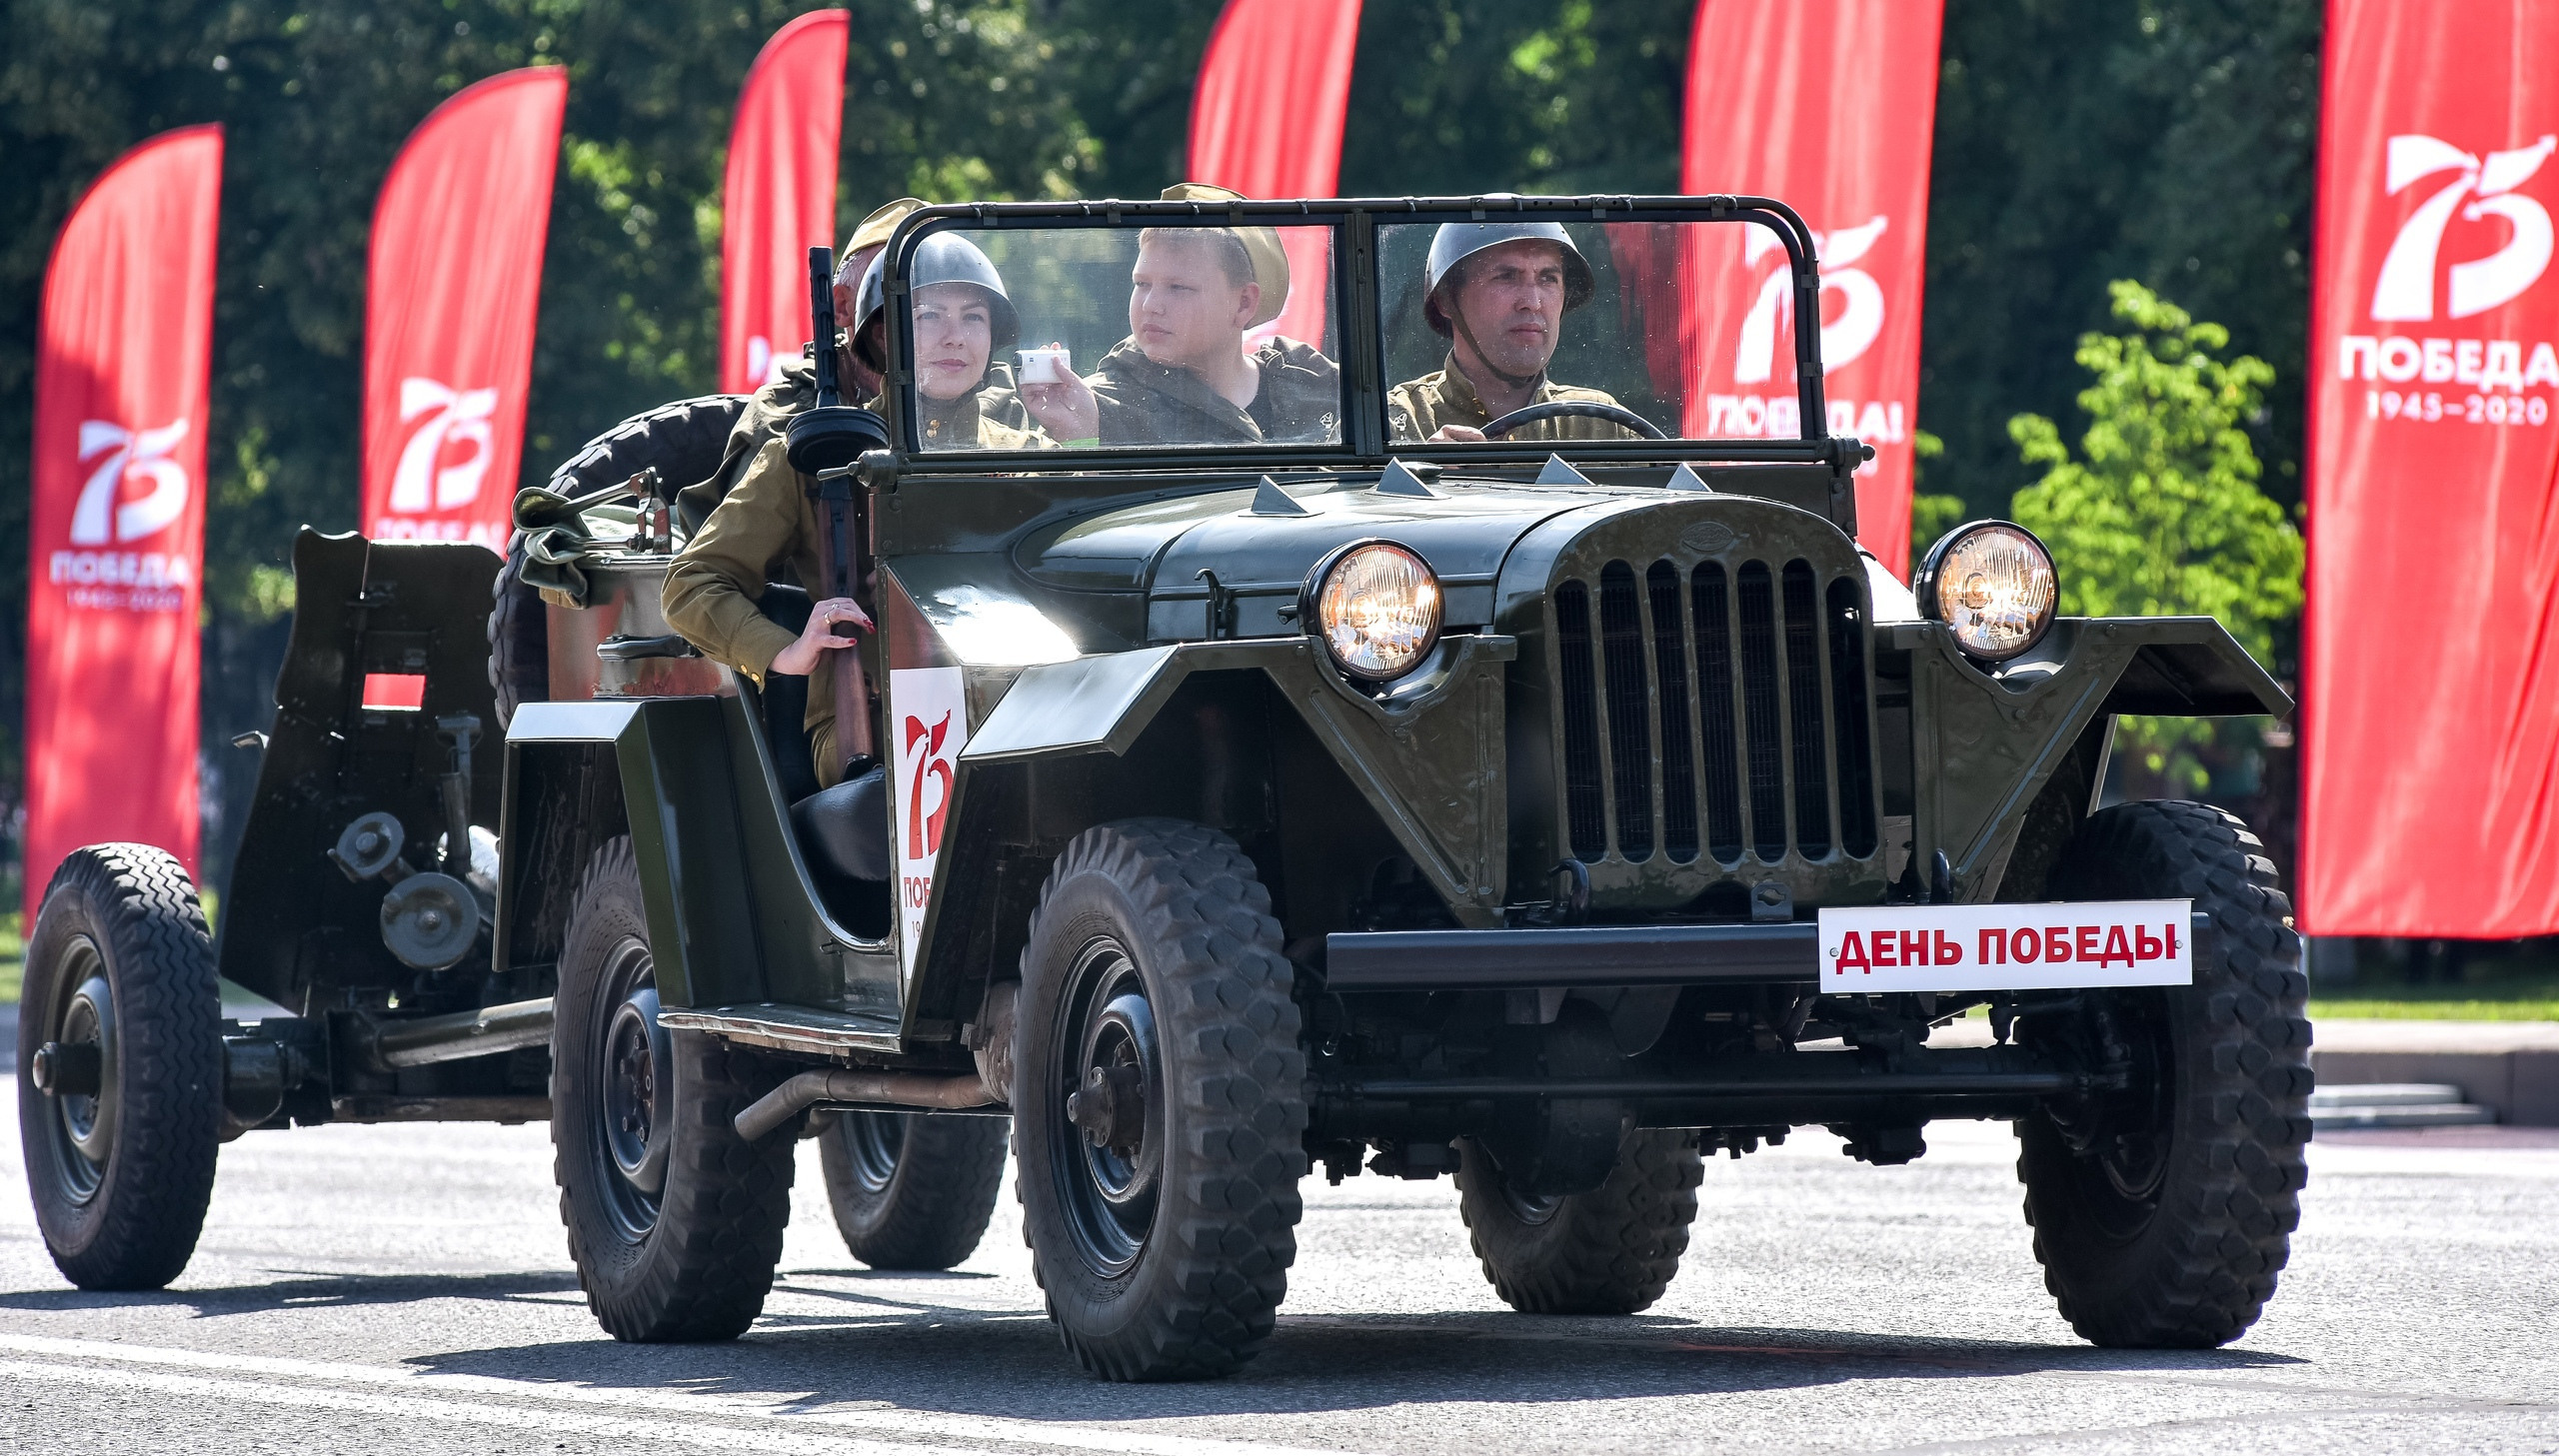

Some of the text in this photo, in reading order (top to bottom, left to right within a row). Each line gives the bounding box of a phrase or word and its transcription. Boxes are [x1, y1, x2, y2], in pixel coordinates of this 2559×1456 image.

[2370, 133, 2558, 322] 75
[69, 418, 190, 546] 75
[388, 376, 499, 514] 75
[1706, 394, 1905, 443] ПОБДА!
[905, 709, 954, 860] 75
[1835, 923, 2177, 975] ДЕНЬ ПОБЕДЫ
